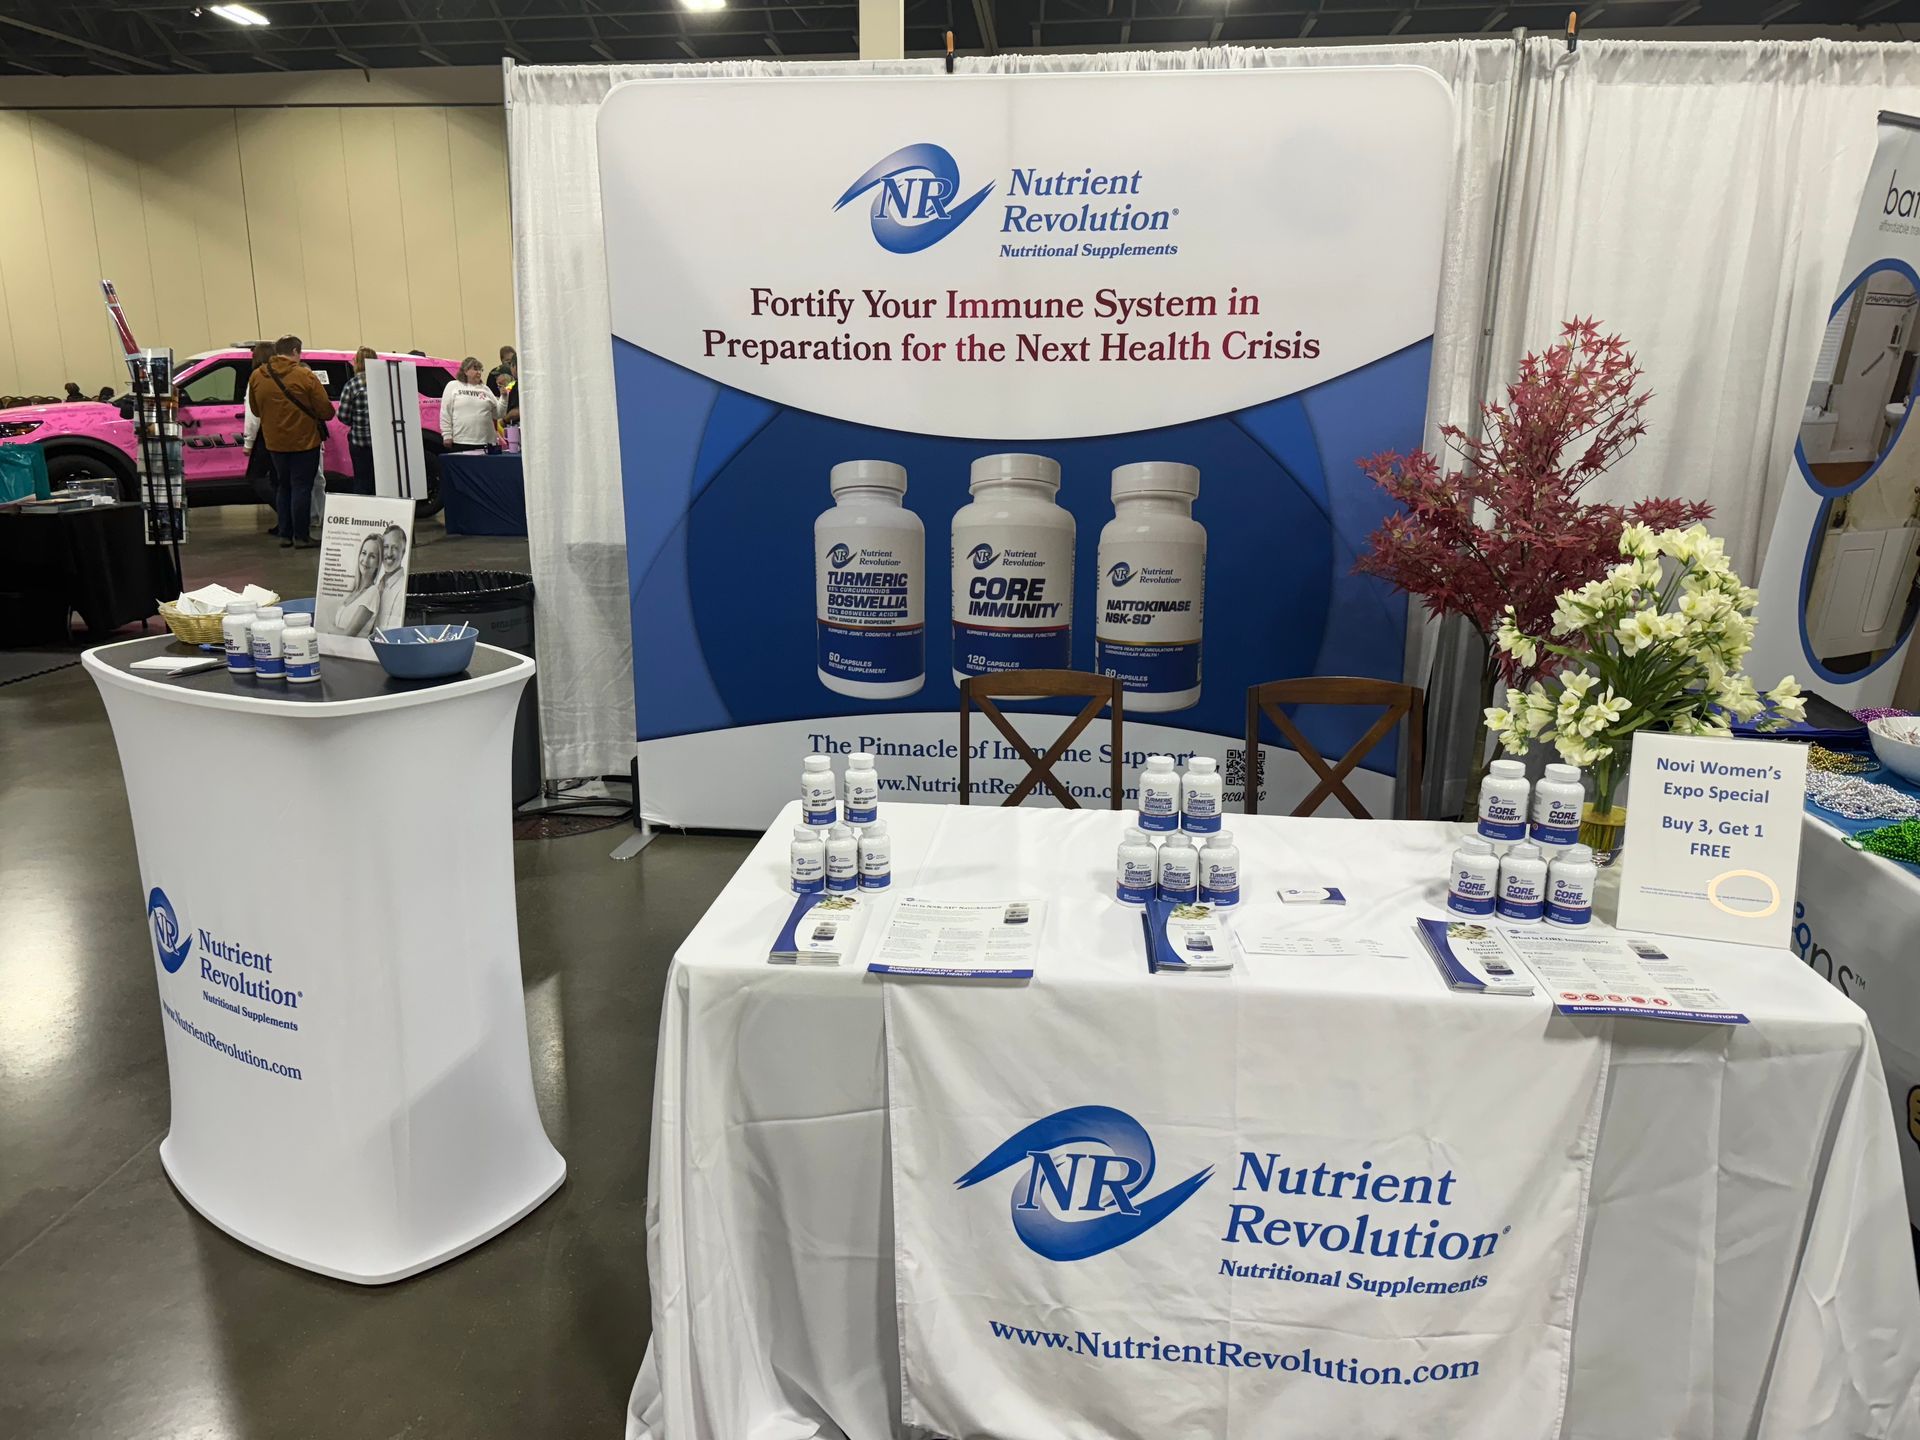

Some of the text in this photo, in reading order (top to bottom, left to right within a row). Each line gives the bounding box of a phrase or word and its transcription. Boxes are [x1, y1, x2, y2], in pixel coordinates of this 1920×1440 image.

[1007, 168, 1142, 196] Nutrient
[874, 177, 952, 220] NR
[1000, 243, 1178, 259] Nutritional Supplements
[751, 287, 1260, 324] Fortify Your Immune System in
[702, 329, 1321, 365] Preparation for the Next Health Crisis
[327, 516, 350, 525] CORE
[860, 549, 892, 557] Nutrient
[1004, 550, 1037, 558] Nutrient
[828, 571, 908, 587] TURMERIC
[1141, 568, 1174, 576] Nutrient
[969, 577, 1046, 601] CORE
[828, 594, 907, 608] BOSWELLIA
[1106, 600, 1191, 612] NATTOKINASE
[829, 652, 872, 667] 60 CAPSULES
[967, 654, 985, 665] 120
[848, 665, 886, 674] SUPPLEMENT
[1105, 668, 1116, 678] 60
[808, 733, 851, 755] The
[859, 736, 958, 759] Pinnacle
[968, 739, 989, 760] of
[1657, 757, 1782, 780] Novi Women's
[1664, 782, 1770, 804] Expo Special
[1488, 806, 1516, 817] CORE
[1488, 813, 1521, 821] IMMUNITY
[1549, 811, 1577, 820] CORE
[1662, 816, 1764, 838] Buy 3, Get 1
[1690, 842, 1731, 859] FREE
[1458, 881, 1486, 891] CORE
[1507, 885, 1534, 895] CORE
[1554, 889, 1583, 900] CORE
[153, 907, 180, 956] NR
[198, 928, 272, 973] Nutrient
[203, 990, 298, 1031] Nutritional Supplements
[162, 998, 302, 1080] www.NutrientRevolution.com
[1017, 1150, 1144, 1216] NR
[1233, 1151, 1457, 1206] Nutrient
[1218, 1258, 1488, 1298] Nutritional Supplements
[989, 1318, 1480, 1386] www.NutrientRevolution.com
